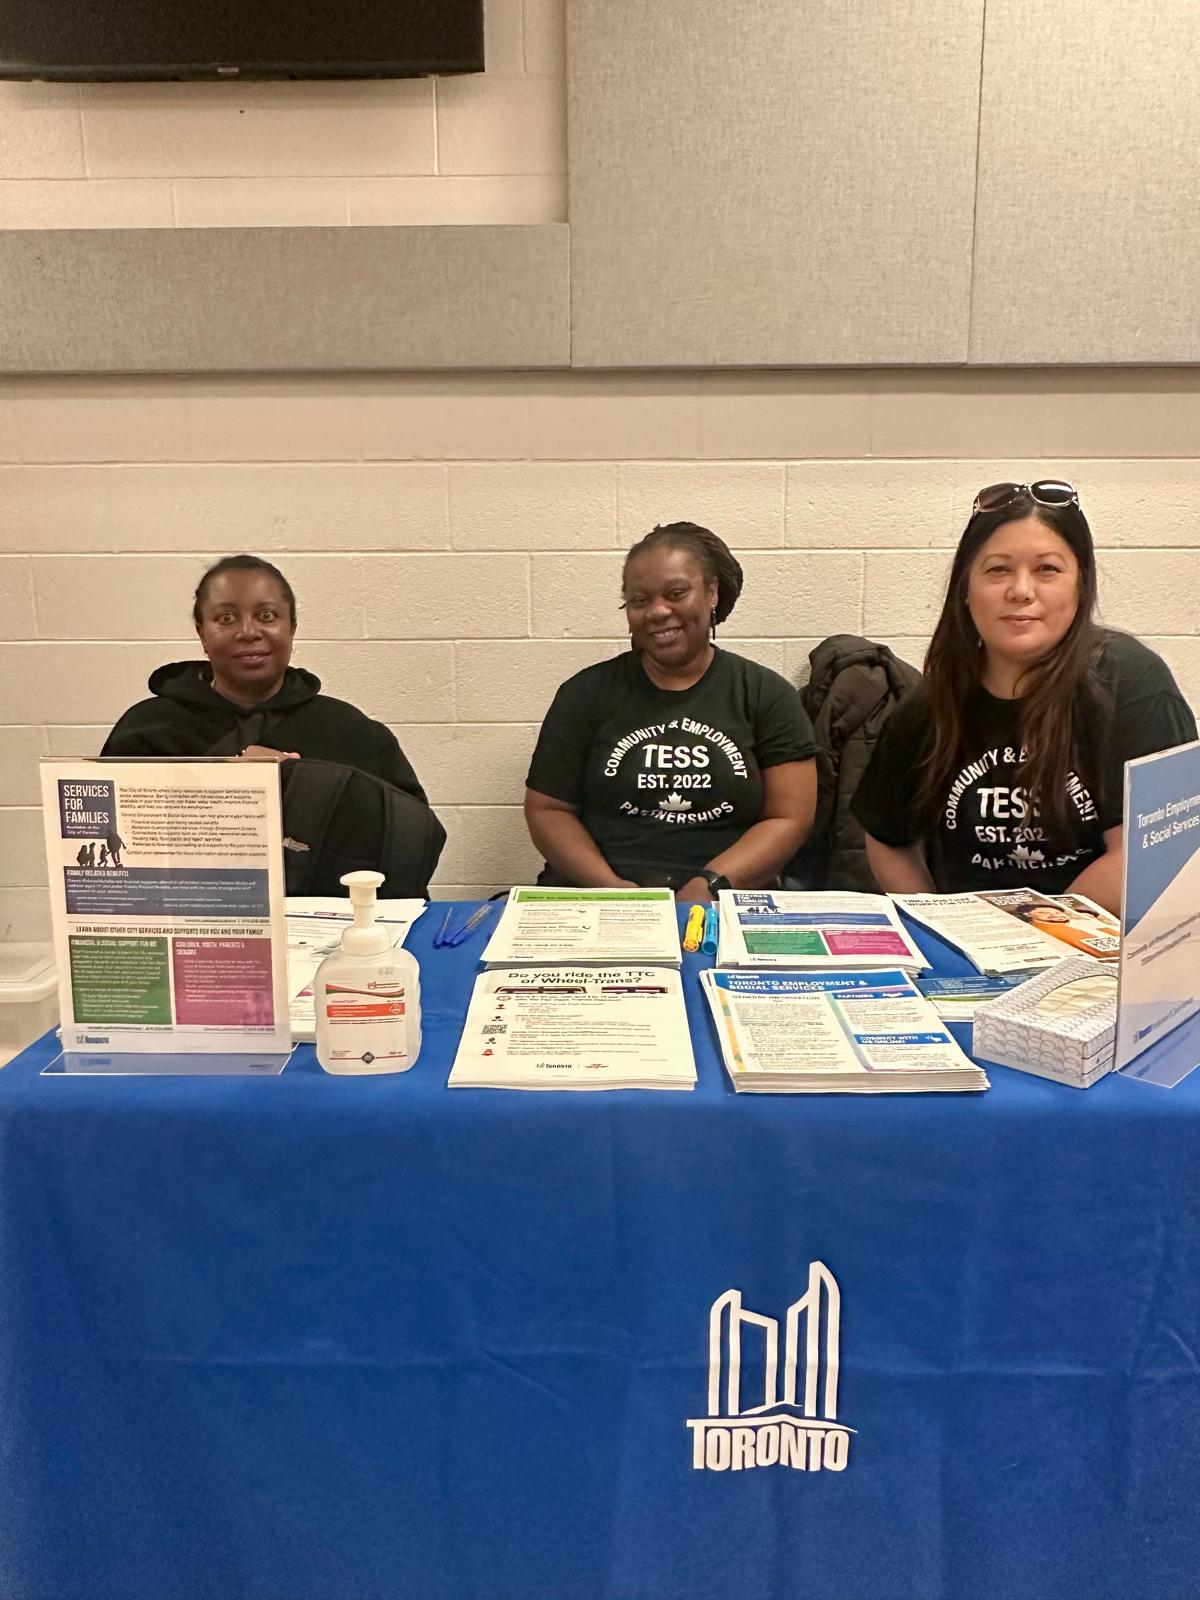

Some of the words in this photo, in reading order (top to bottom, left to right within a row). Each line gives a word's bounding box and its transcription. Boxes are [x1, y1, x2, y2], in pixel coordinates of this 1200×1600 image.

[604, 724, 665, 777] COMMUNITY
[668, 720, 679, 729] &
[681, 717, 748, 779] EMPLOYMENT
[642, 744, 710, 768] TESS
[63, 784, 109, 797] SERVICES
[637, 774, 669, 788] EST.
[673, 774, 712, 788] 2022
[946, 749, 998, 830] COMMUNITY
[1003, 747, 1016, 763] &
[64, 798, 83, 810] FOR
[65, 811, 109, 824] FAMILIES
[1137, 808, 1165, 829] Toronto
[975, 826, 1011, 843] EST.
[1012, 828, 1047, 844] 202
[1143, 834, 1148, 849] &
[1150, 823, 1171, 846] Social
[1172, 815, 1200, 835] Services
[687, 1416, 855, 1472] TORONTO
